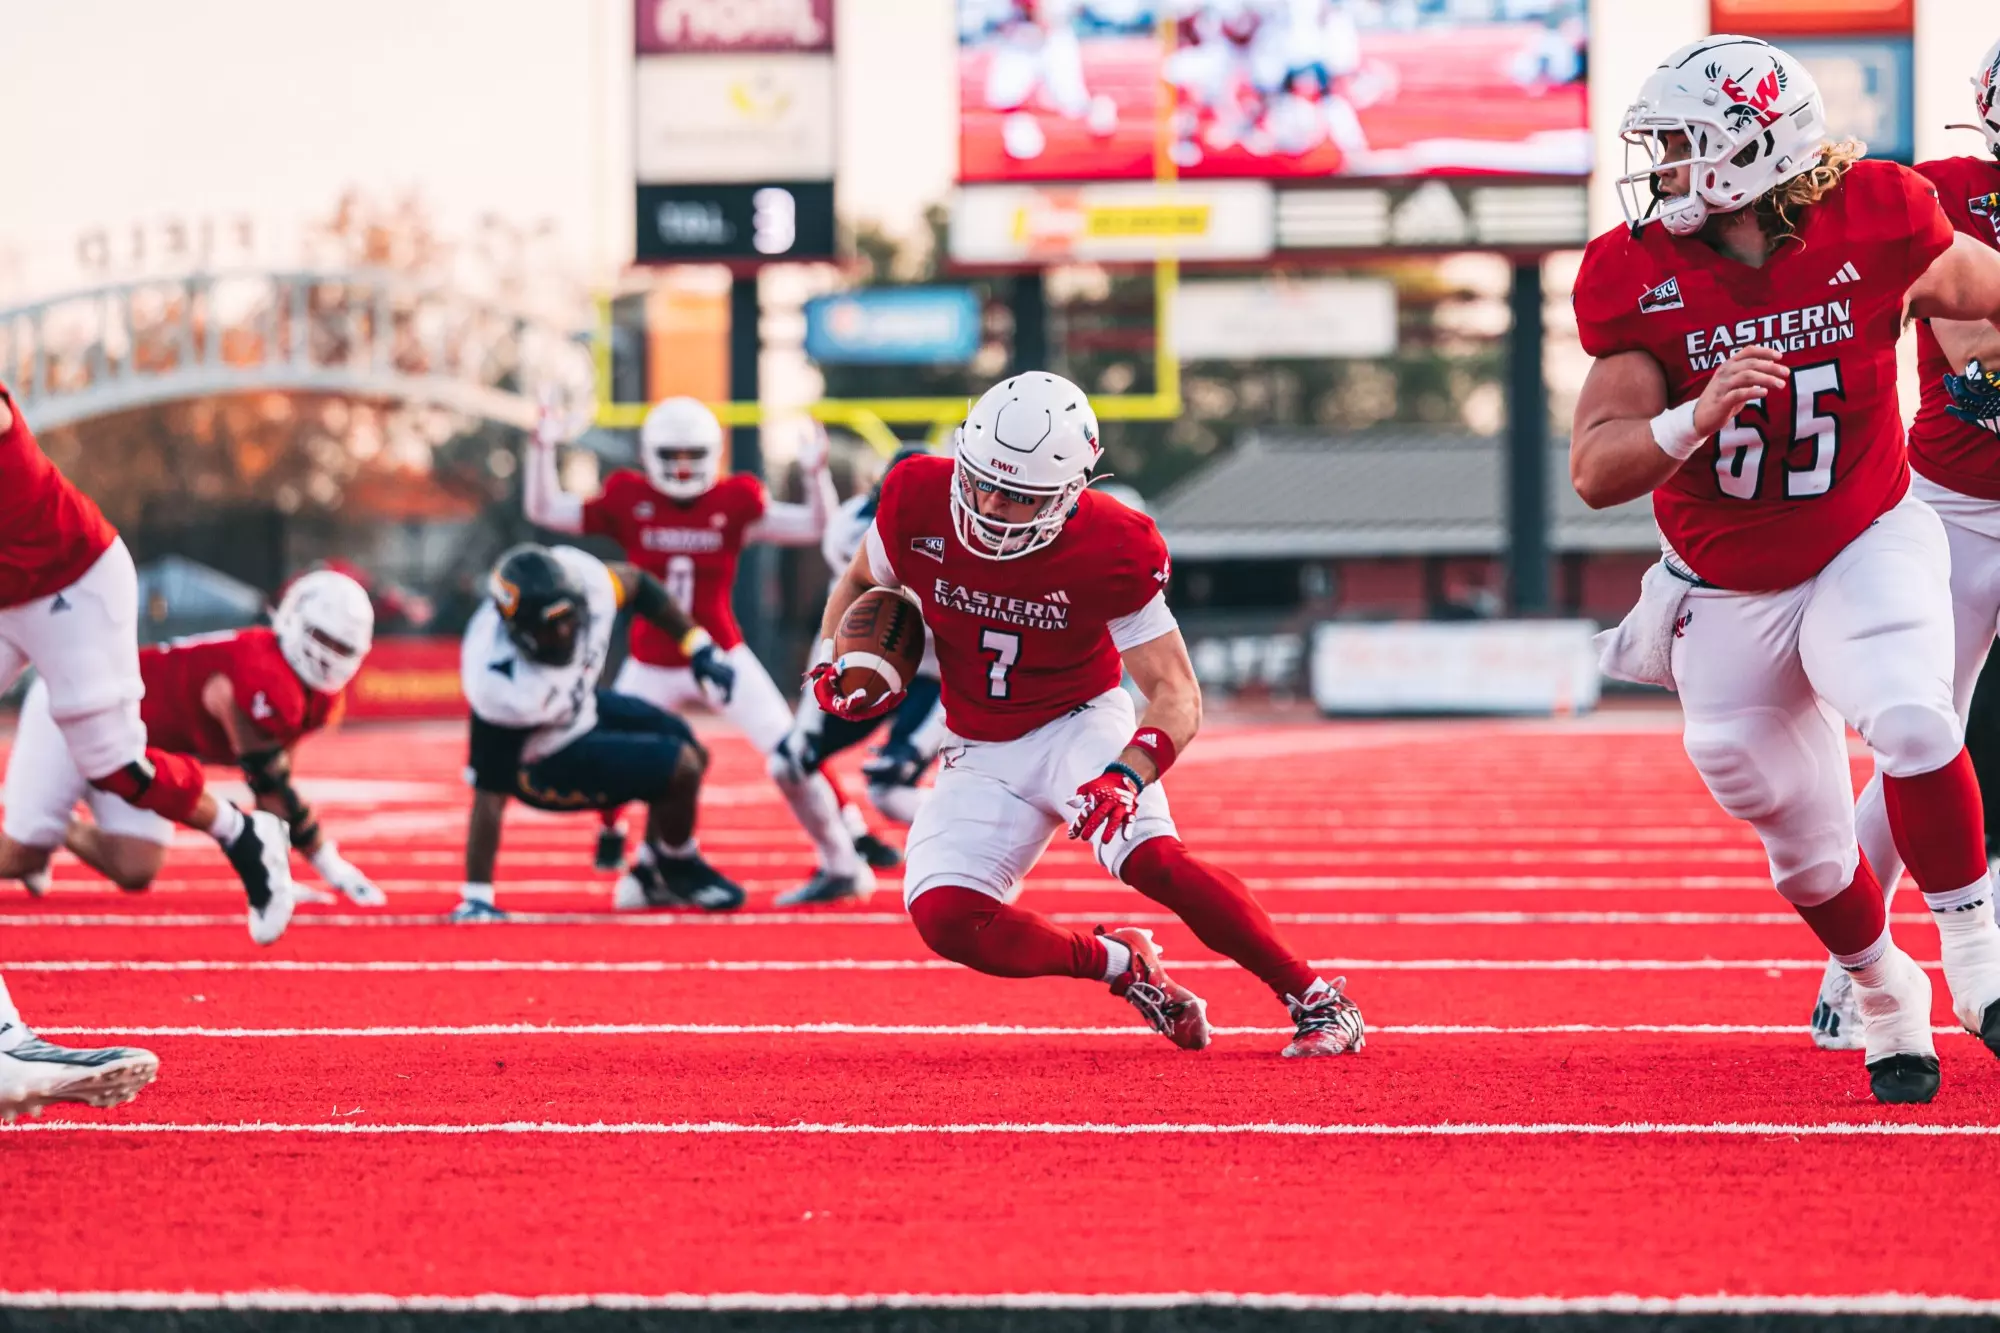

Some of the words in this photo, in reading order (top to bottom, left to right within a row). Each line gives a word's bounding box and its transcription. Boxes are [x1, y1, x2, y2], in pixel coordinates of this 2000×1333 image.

[752, 186, 796, 255] 3
[1654, 280, 1678, 301] SKY
[1686, 299, 1852, 355] EASTERN
[1689, 322, 1854, 372] WANGTON
[1714, 358, 1847, 501] 65
[990, 458, 1019, 475] EWU
[925, 539, 943, 551] SKY
[934, 578, 1068, 620] EASTERN
[934, 592, 1068, 630] WASHINGTON
[978, 626, 1022, 699] 7
